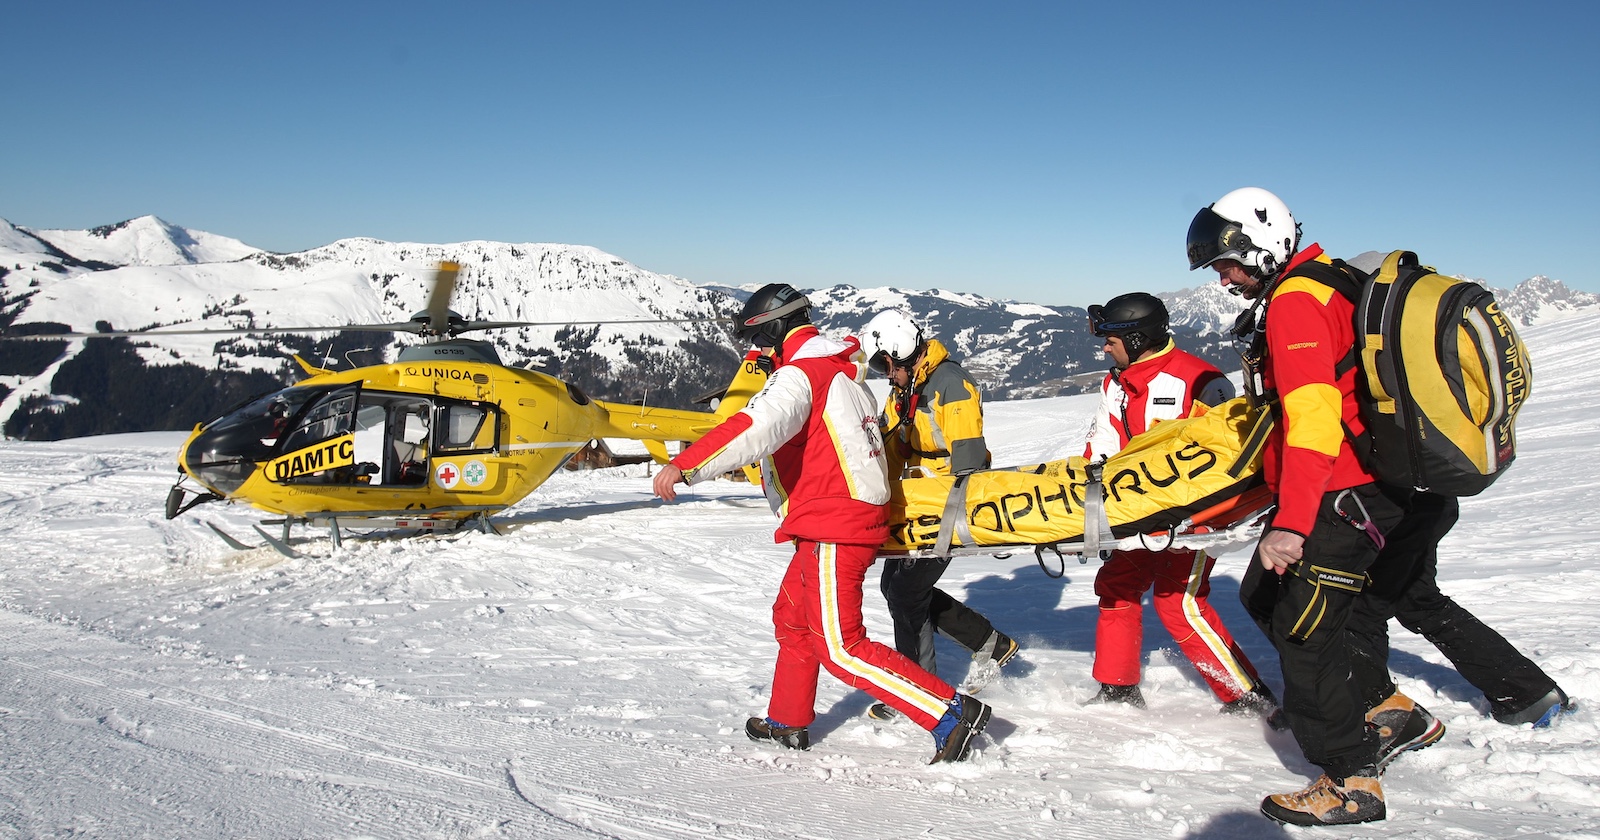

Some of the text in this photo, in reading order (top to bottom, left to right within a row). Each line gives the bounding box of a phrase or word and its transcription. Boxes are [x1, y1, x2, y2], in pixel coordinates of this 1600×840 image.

[1106, 321, 1139, 329] SCOTT
[422, 367, 472, 380] UNIQA
[504, 449, 526, 457] NOTRUF
[1318, 574, 1354, 584] MAMMUT
